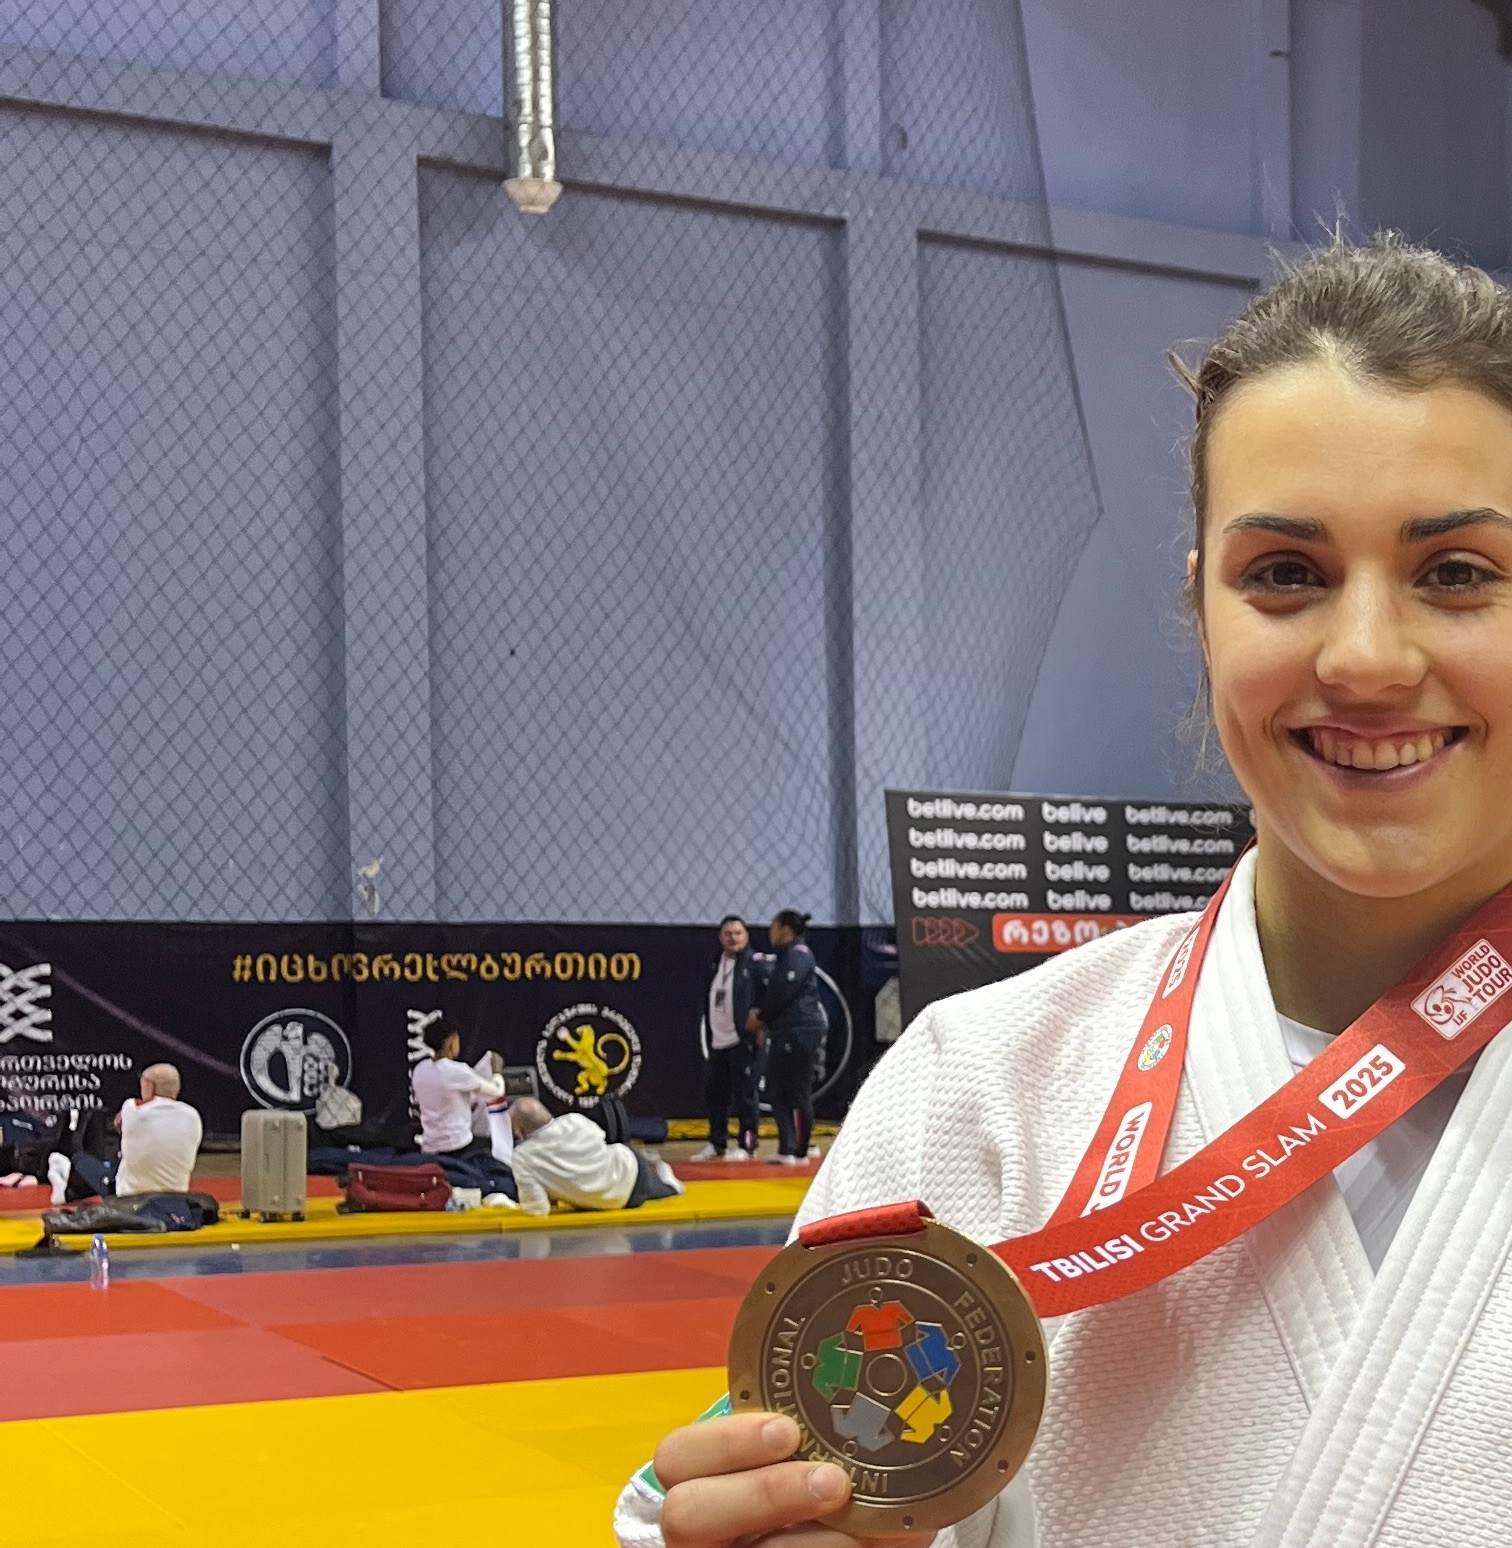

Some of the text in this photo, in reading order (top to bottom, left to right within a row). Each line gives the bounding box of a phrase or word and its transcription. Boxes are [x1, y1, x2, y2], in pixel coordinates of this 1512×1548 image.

[907, 798, 1024, 822] betlive.com
[1125, 805, 1232, 826] betlive.com
[909, 827, 1026, 851] betlive.com
[1126, 834, 1234, 855] betlive.com
[910, 857, 1027, 881] betlive.com
[912, 887, 1029, 910] betlive.com
[1129, 891, 1208, 911] betlive.c
[1451, 944, 1491, 979] WORLD
[1461, 955, 1502, 993] JUDO
[1331, 1054, 1394, 1110] 2025
[1099, 1111, 1145, 1197] WORLD
[1030, 1112, 1327, 1283] TBILISI GRAND SLAM
[841, 1256, 914, 1284] JUDO
[949, 1291, 1004, 1466] FEDERATION
